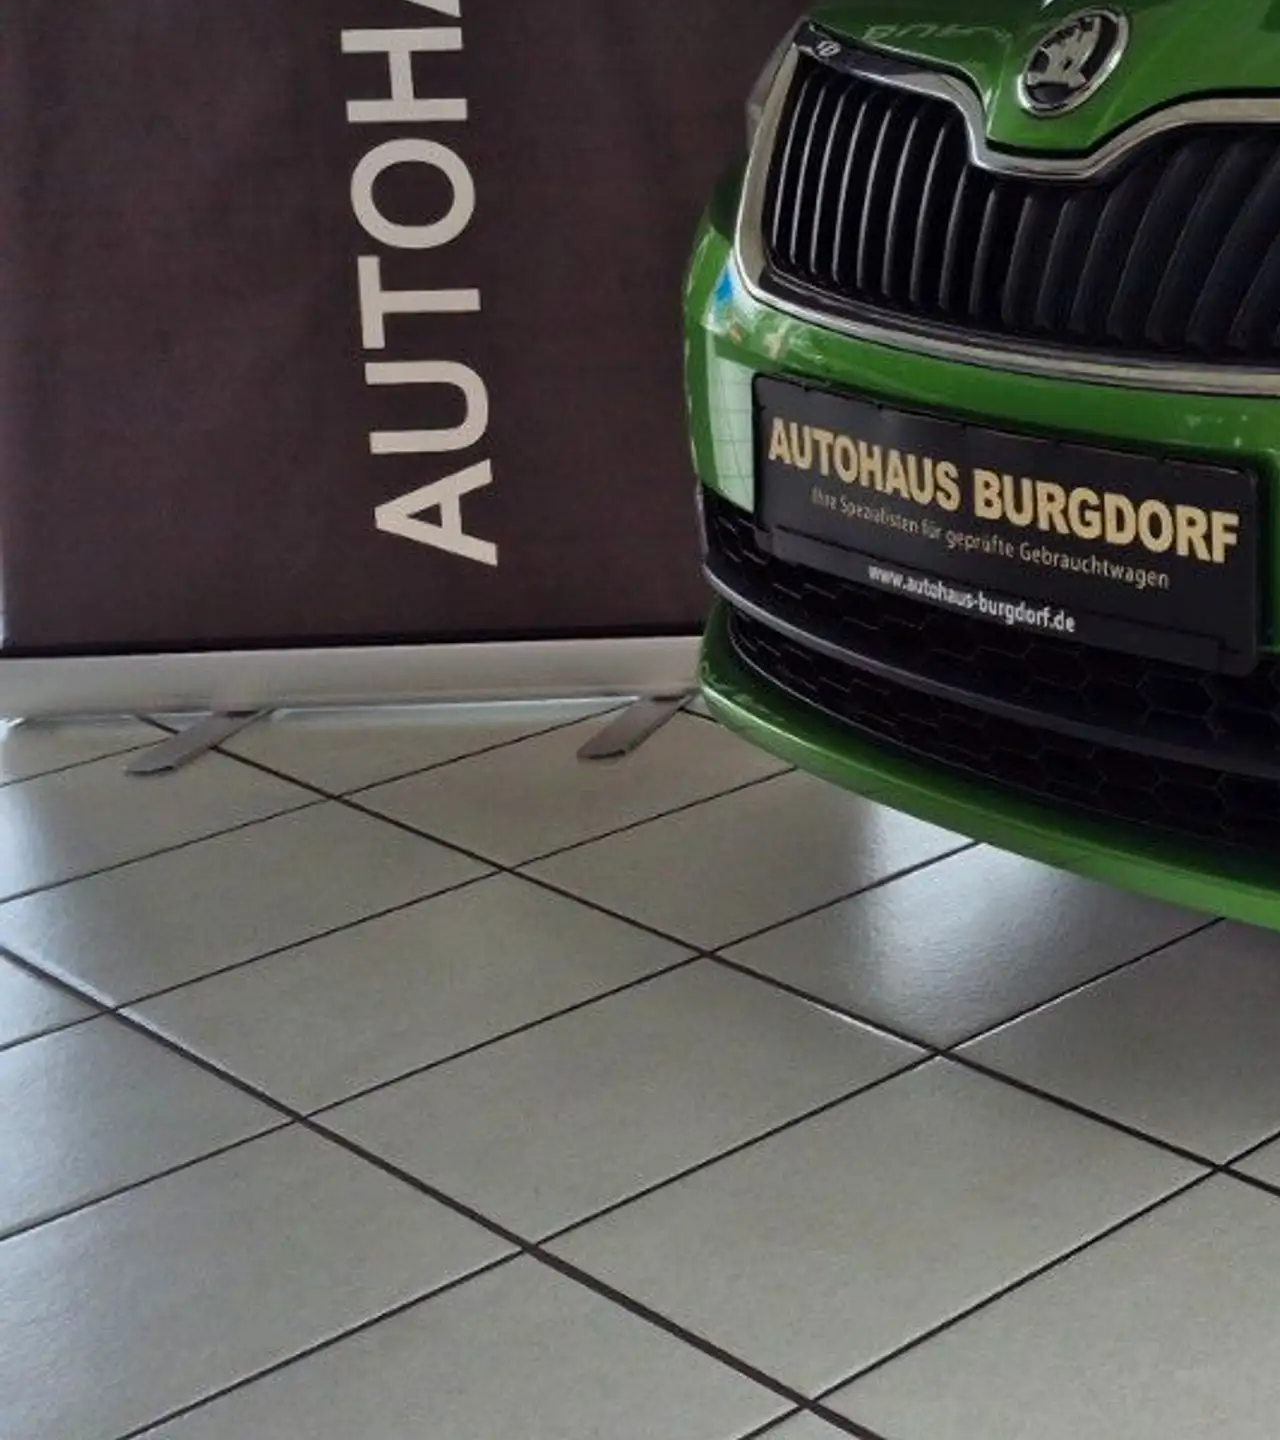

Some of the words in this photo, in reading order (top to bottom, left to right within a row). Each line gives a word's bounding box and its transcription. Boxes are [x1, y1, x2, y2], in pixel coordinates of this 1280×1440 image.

[767, 416, 962, 512] AUTOHAUS
[972, 467, 1240, 564] BURGDORF
[811, 486, 838, 510] Ihre
[839, 494, 919, 534] Spezialisten
[920, 517, 942, 540] für
[1019, 541, 1170, 590] Gebrauchtwagen
[868, 563, 1076, 633] www.autohaus-burgdorf.de
